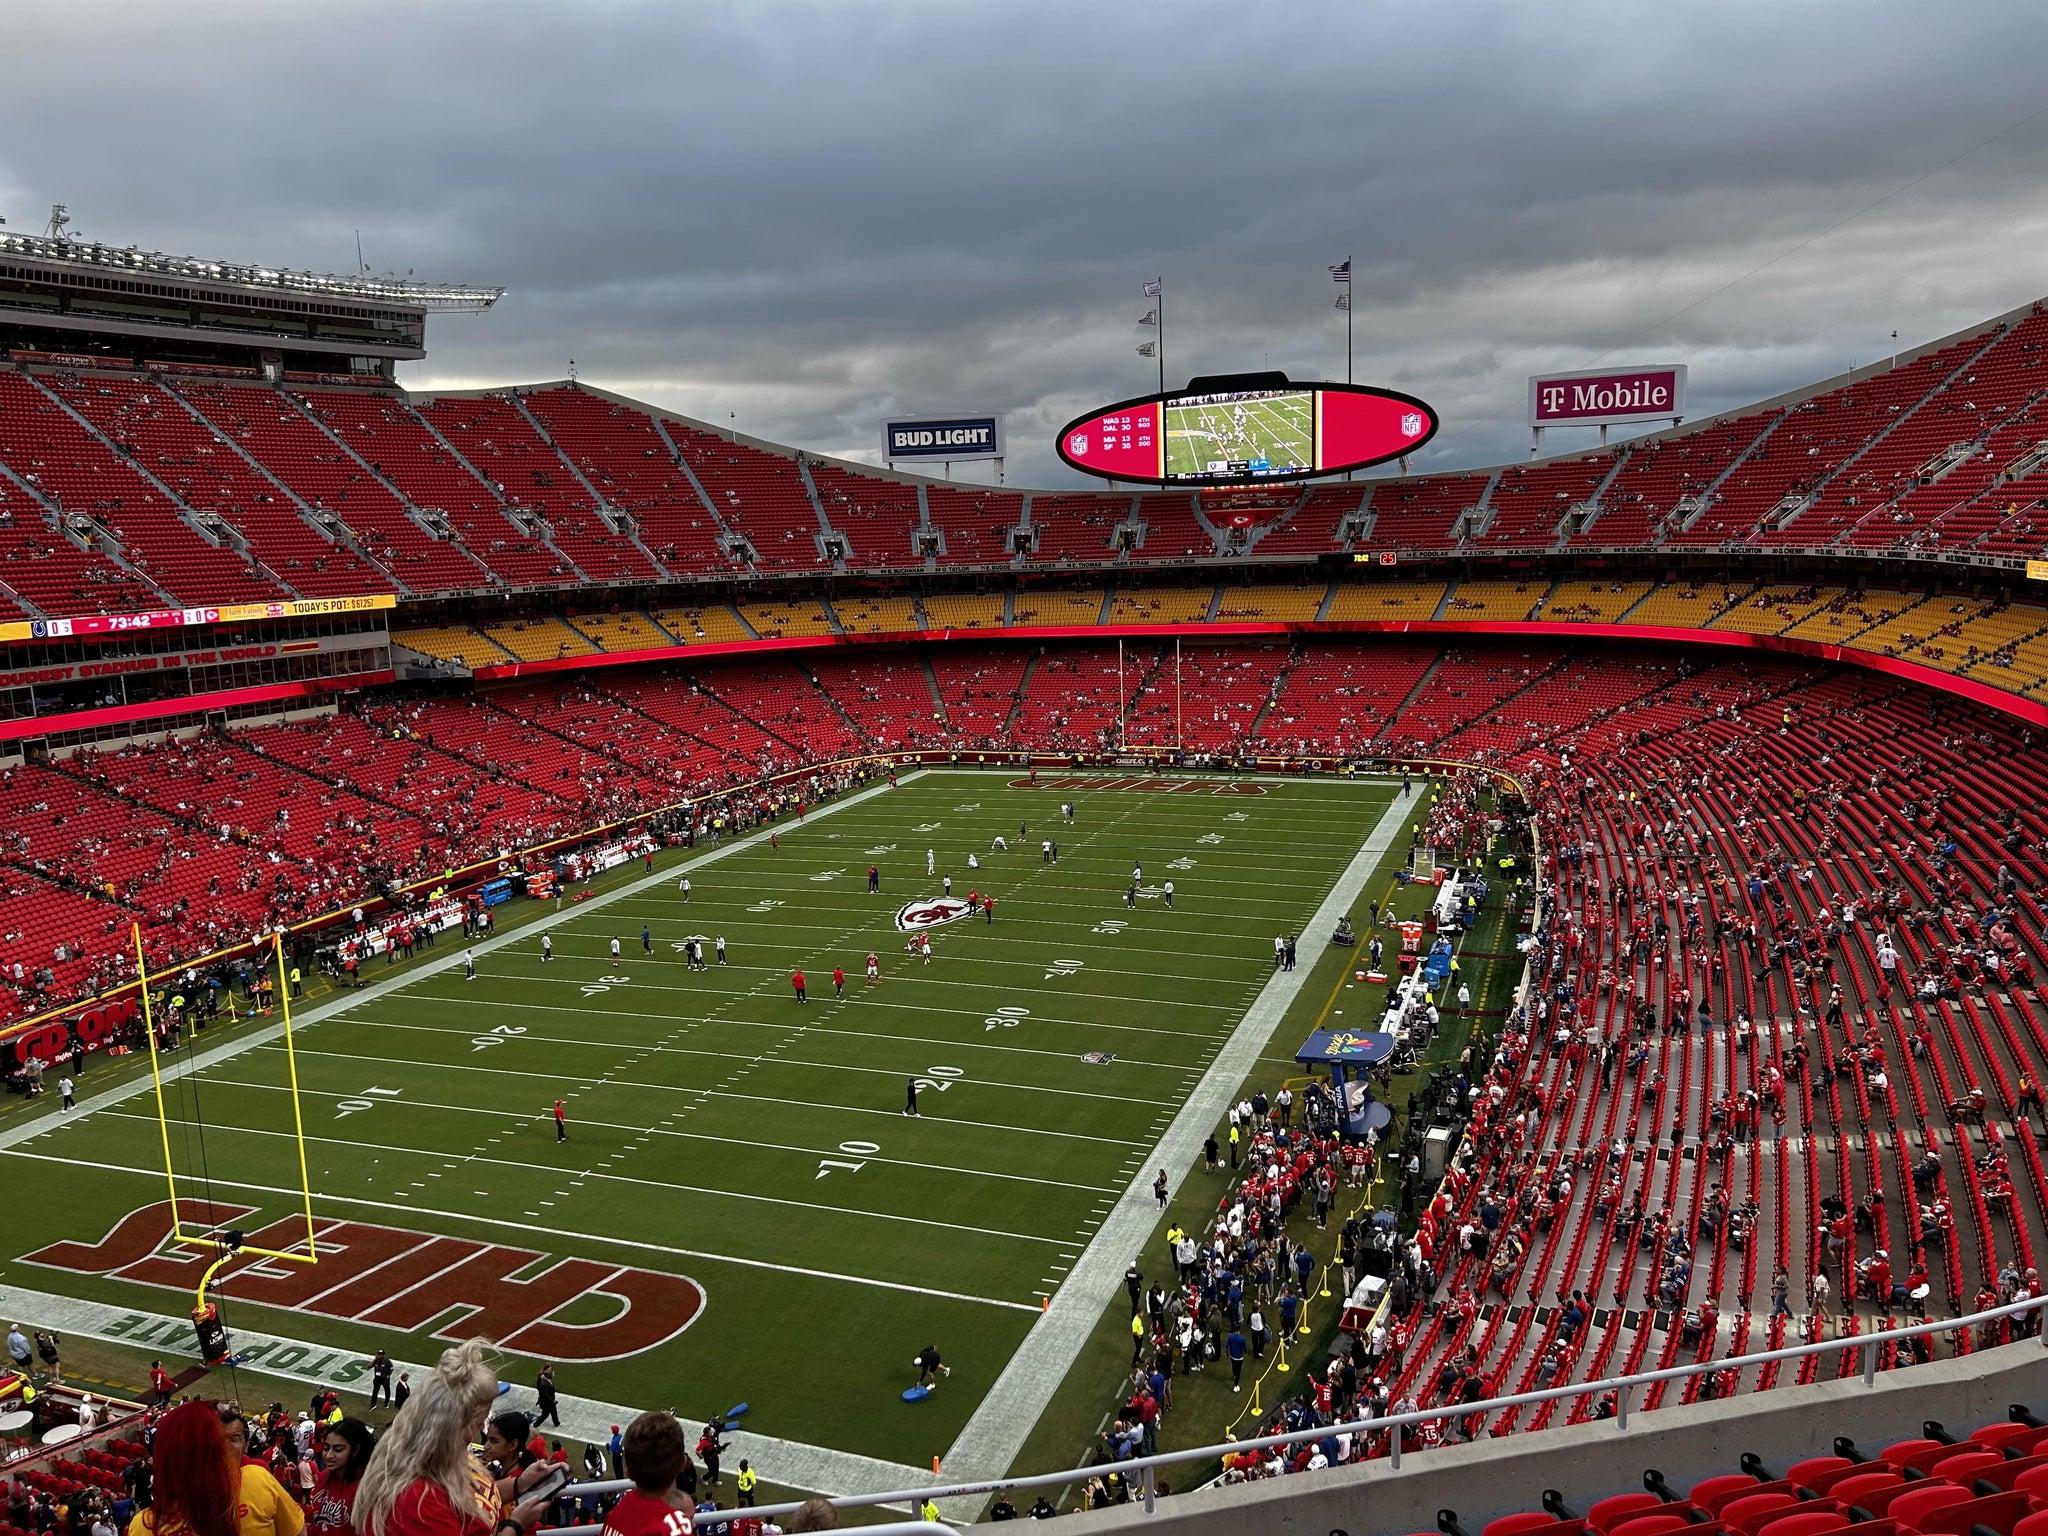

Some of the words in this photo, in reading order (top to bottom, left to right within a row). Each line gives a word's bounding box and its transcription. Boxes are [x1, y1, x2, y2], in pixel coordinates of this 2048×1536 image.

[1543, 387, 1565, 412] T
[1571, 380, 1668, 411] Mobile
[894, 431, 934, 447] BUD
[935, 429, 989, 445] LIGHT
[1382, 554, 1394, 563] 25
[243, 606, 263, 616] Family
[293, 601, 329, 613] TODAY'S
[331, 600, 350, 610] POT:
[52, 622, 58, 634] 0
[108, 615, 150, 629] 73:42
[0, 667, 74, 687] OUDEST
[79, 658, 158, 677] STADIUM
[163, 655, 181, 667] IN
[185, 651, 217, 664] THE
[220, 645, 277, 660] WORLD
[1006, 777, 1285, 795] CHIEFS
[1335, 1085, 1344, 1109] FNIA
[1737, 1103, 1746, 1111] 15
[1355, 1154, 1363, 1163] 15
[11, 1197, 707, 1363] CHIEFS
[1396, 1332, 1406, 1344] 87
[239, 1340, 372, 1383] STOP
[1324, 1391, 1331, 1401] 15
[1425, 1429, 1437, 1440] 15
[663, 1510, 692, 1536] 15
